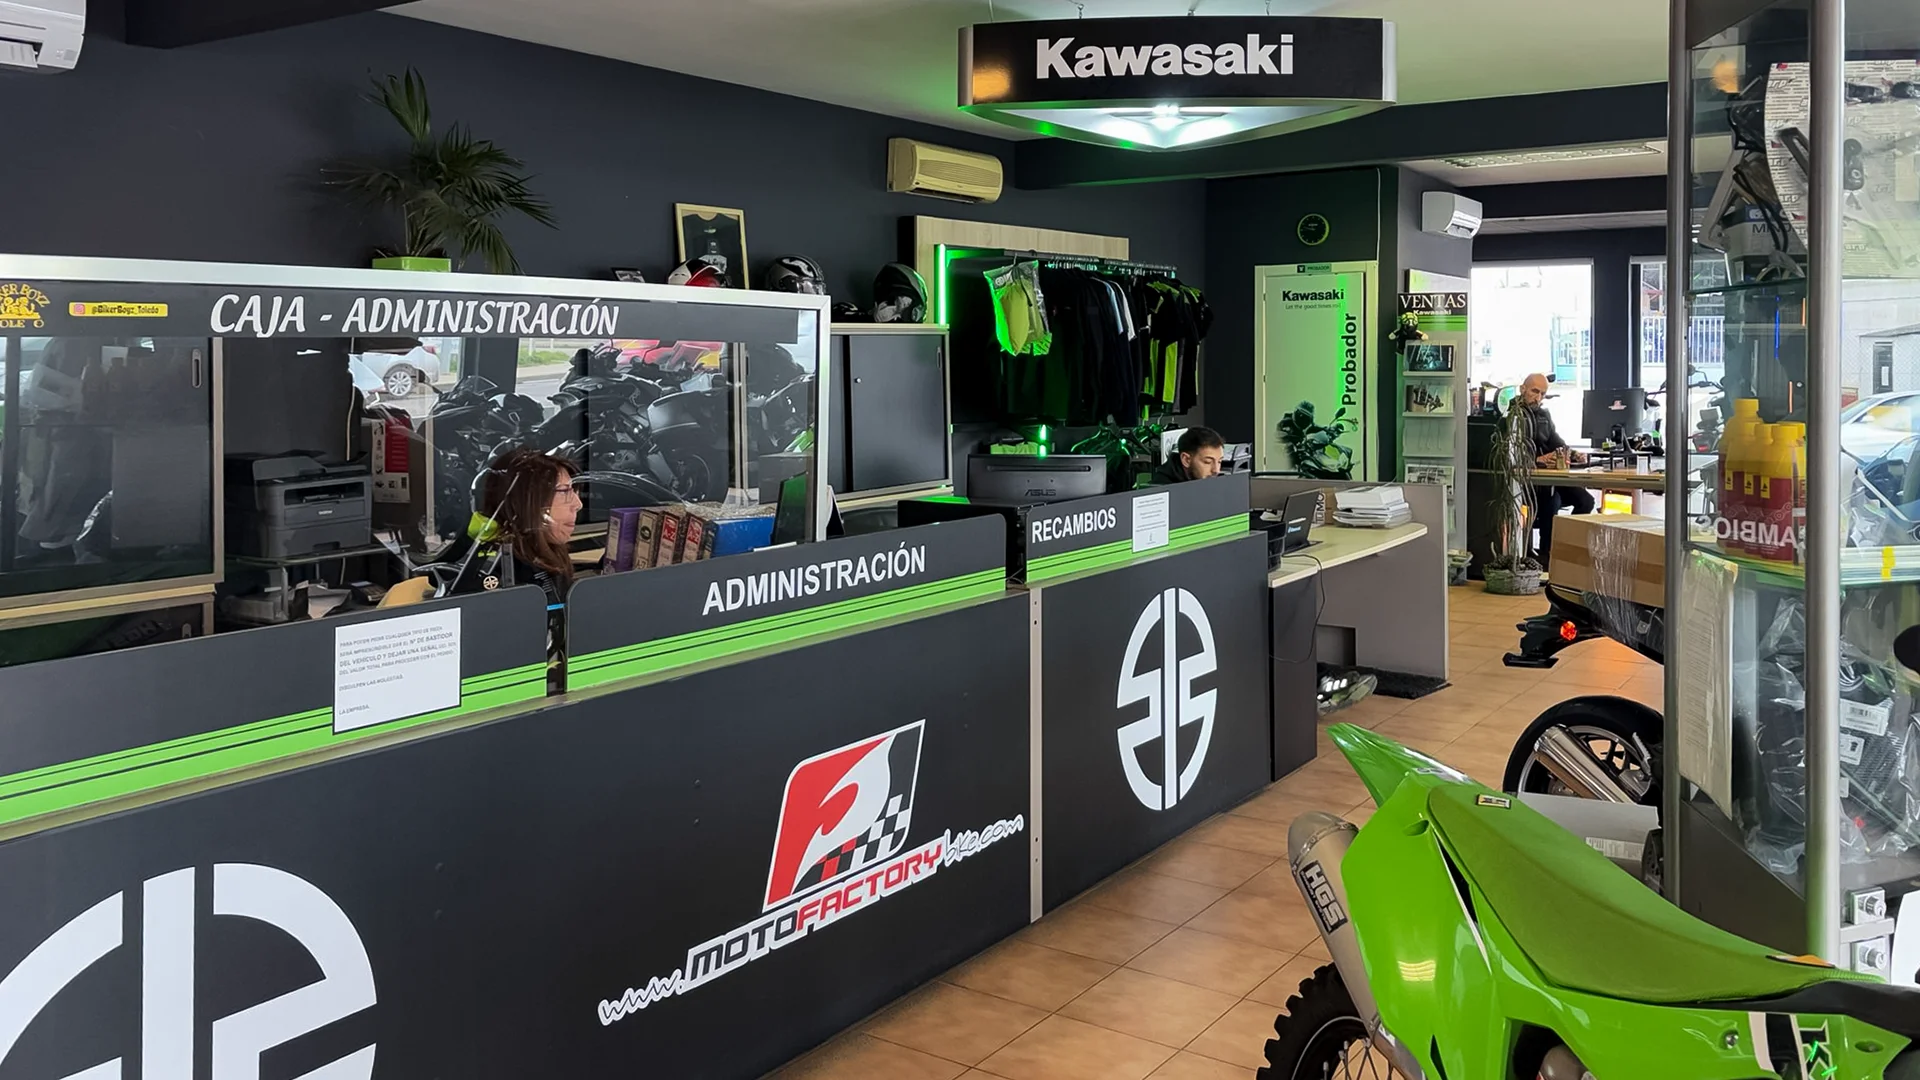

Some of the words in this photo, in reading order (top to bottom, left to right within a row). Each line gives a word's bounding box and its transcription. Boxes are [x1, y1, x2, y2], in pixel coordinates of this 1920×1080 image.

[1036, 33, 1294, 80] Kawasaki
[20, 284, 51, 307] BOYZ
[1282, 289, 1345, 301] Kawasaki
[1400, 294, 1467, 308] VENTAS
[210, 294, 306, 338] CAJA
[319, 312, 333, 322] -
[342, 298, 620, 336] ADMINISTRACIÓN
[1341, 313, 1357, 405] Probador
[1032, 507, 1117, 544] RECAMBIOS
[702, 542, 926, 616] ADMINISTRACIÓN
[425, 631, 452, 641] BASTIDOR
[1304, 864, 1345, 927] HGS
